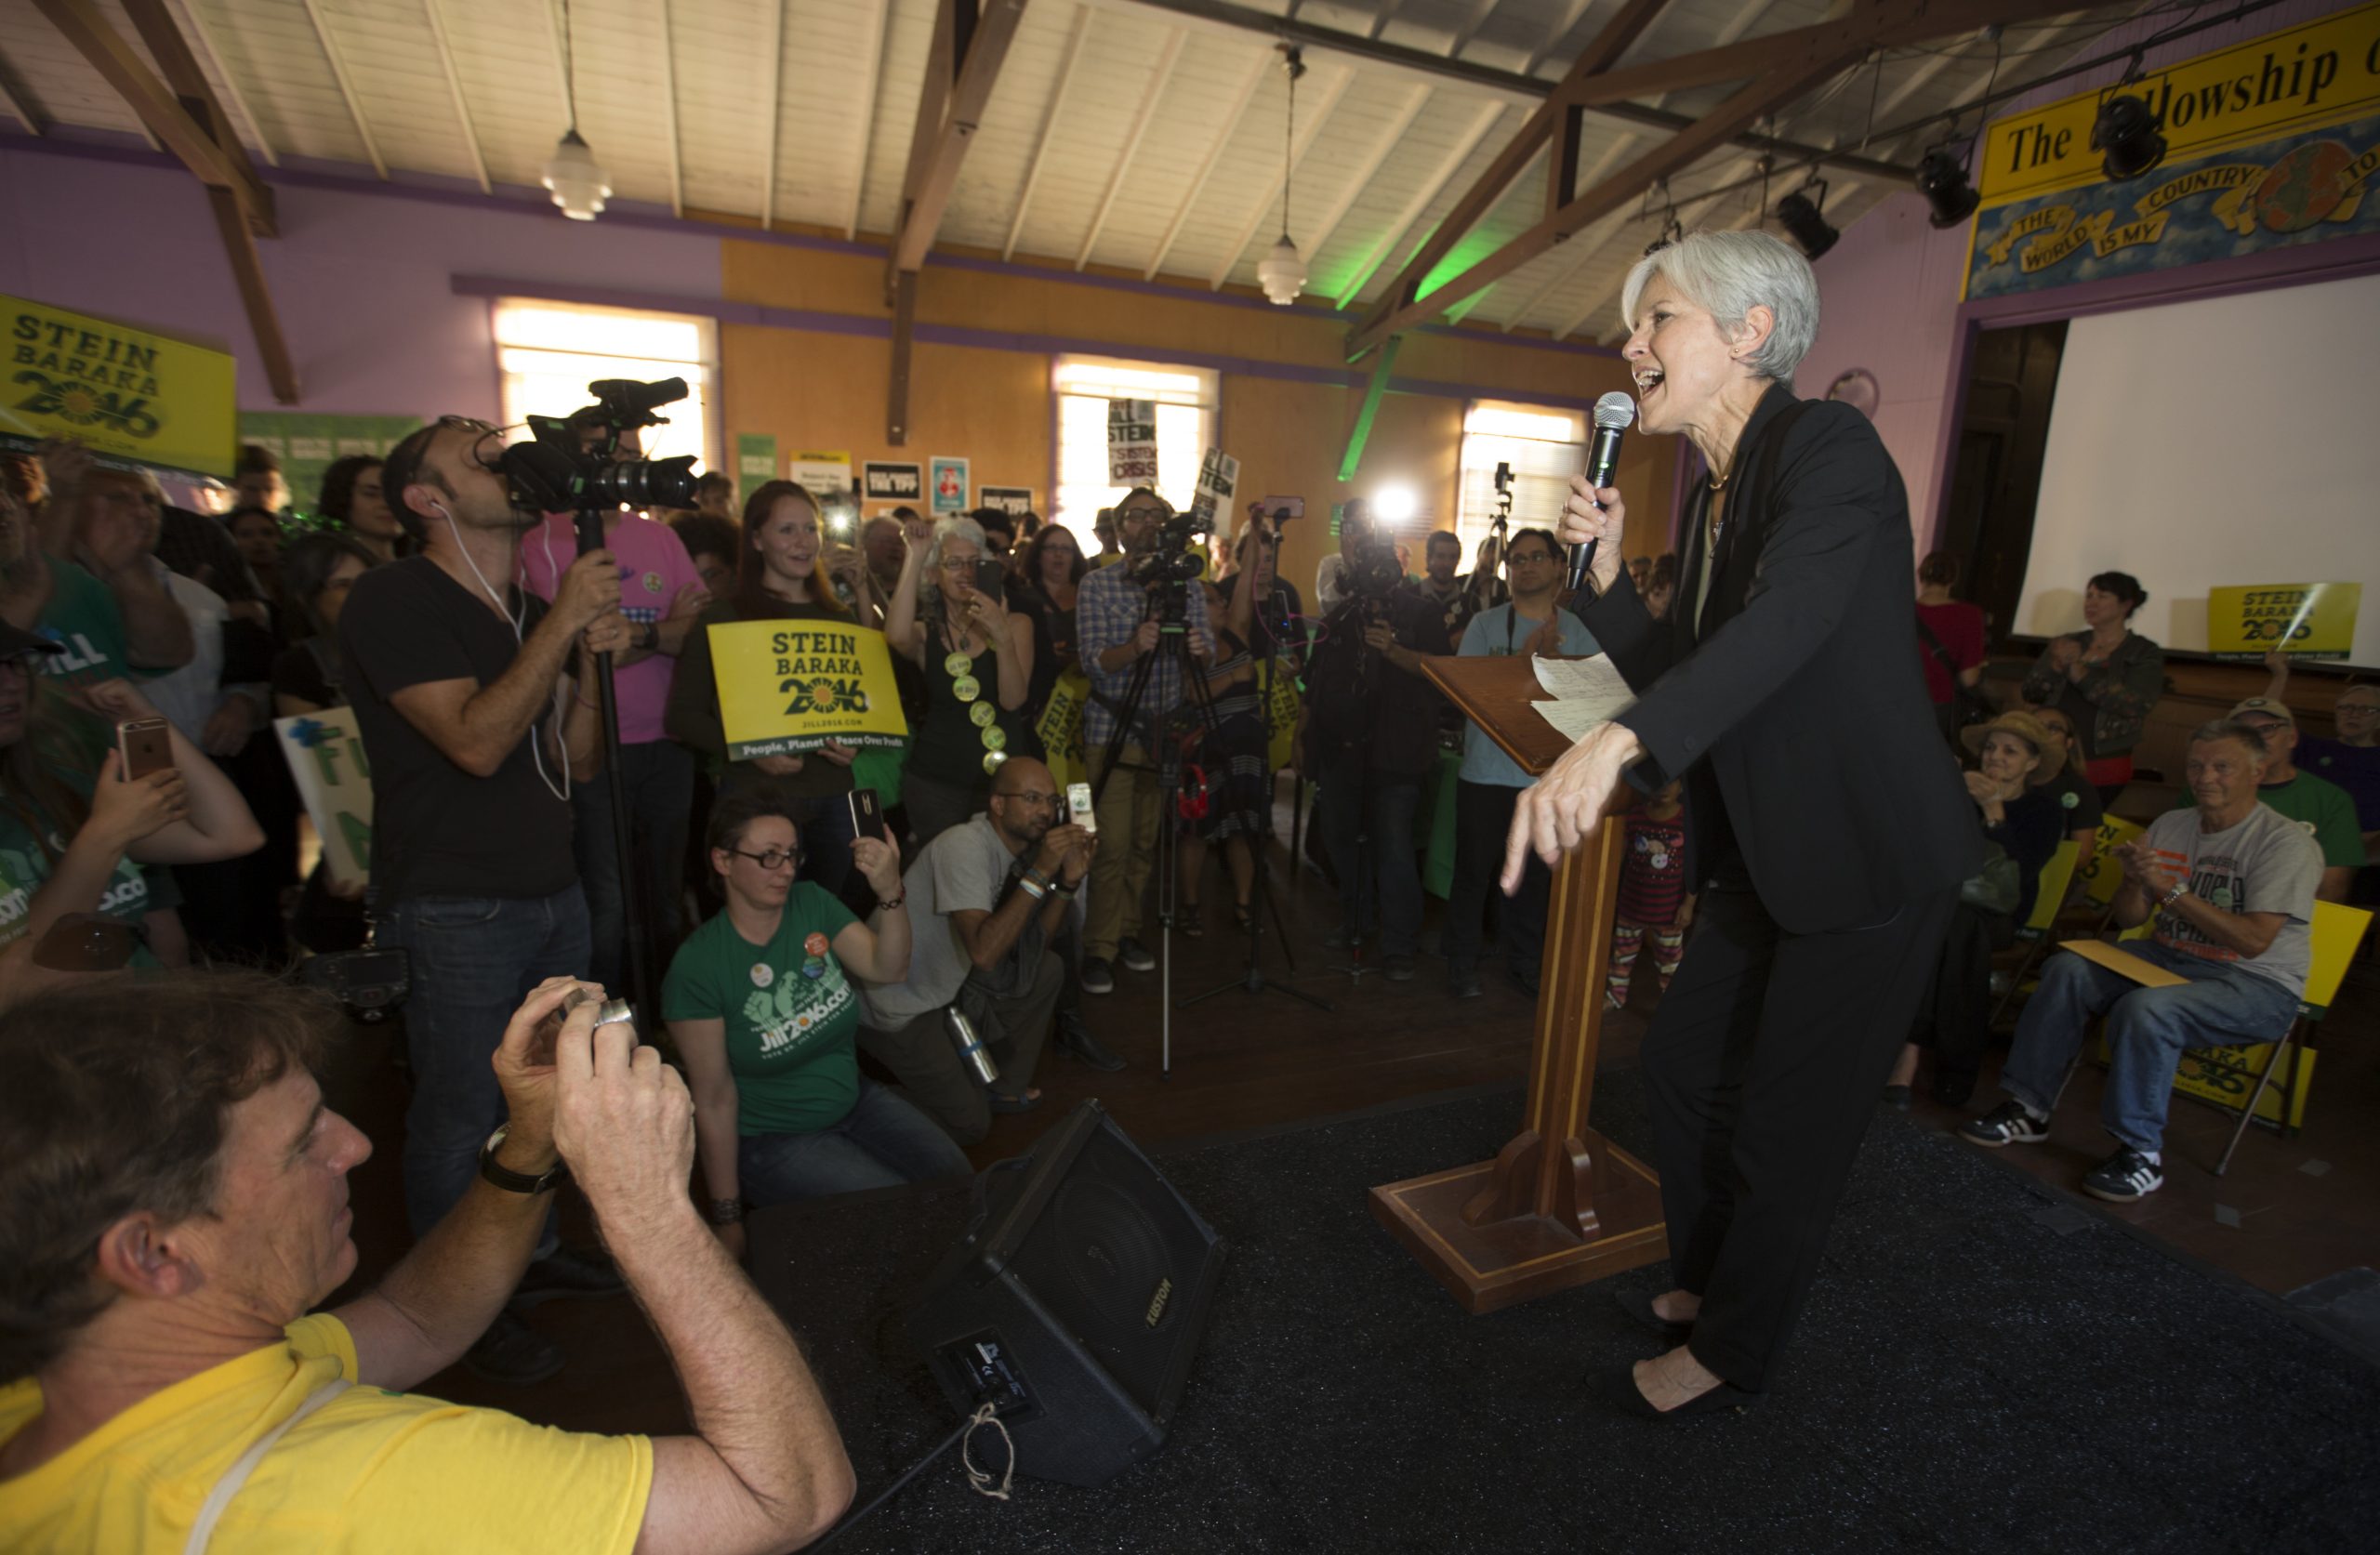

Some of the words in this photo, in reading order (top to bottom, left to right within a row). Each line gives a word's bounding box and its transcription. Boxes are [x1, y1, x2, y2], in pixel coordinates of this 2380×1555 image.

[2008, 123, 2071, 174] The
[2091, 43, 2337, 152] llowship
[2342, 152, 2376, 180] TO
[2149, 167, 2257, 207] COUNTRY
[2019, 208, 2056, 233] THE
[2100, 235, 2117, 254] IS
[2123, 222, 2158, 243] MY
[2026, 227, 2088, 270] WORLD
[12, 314, 161, 372] STEIN
[12, 344, 159, 396] BARAKA
[11, 370, 160, 439] 2016
[1108, 425, 1156, 442] STEIN
[38, 633, 110, 675] ILL
[773, 632, 855, 655] STEIN
[775, 658, 863, 676] BARAKA
[779, 677, 869, 716] 2016
[742, 744, 786, 757] People,
[787, 739, 825, 751] Planet
[835, 735, 863, 747] Peace
[1145, 1278, 1172, 1328] KUSTOM
